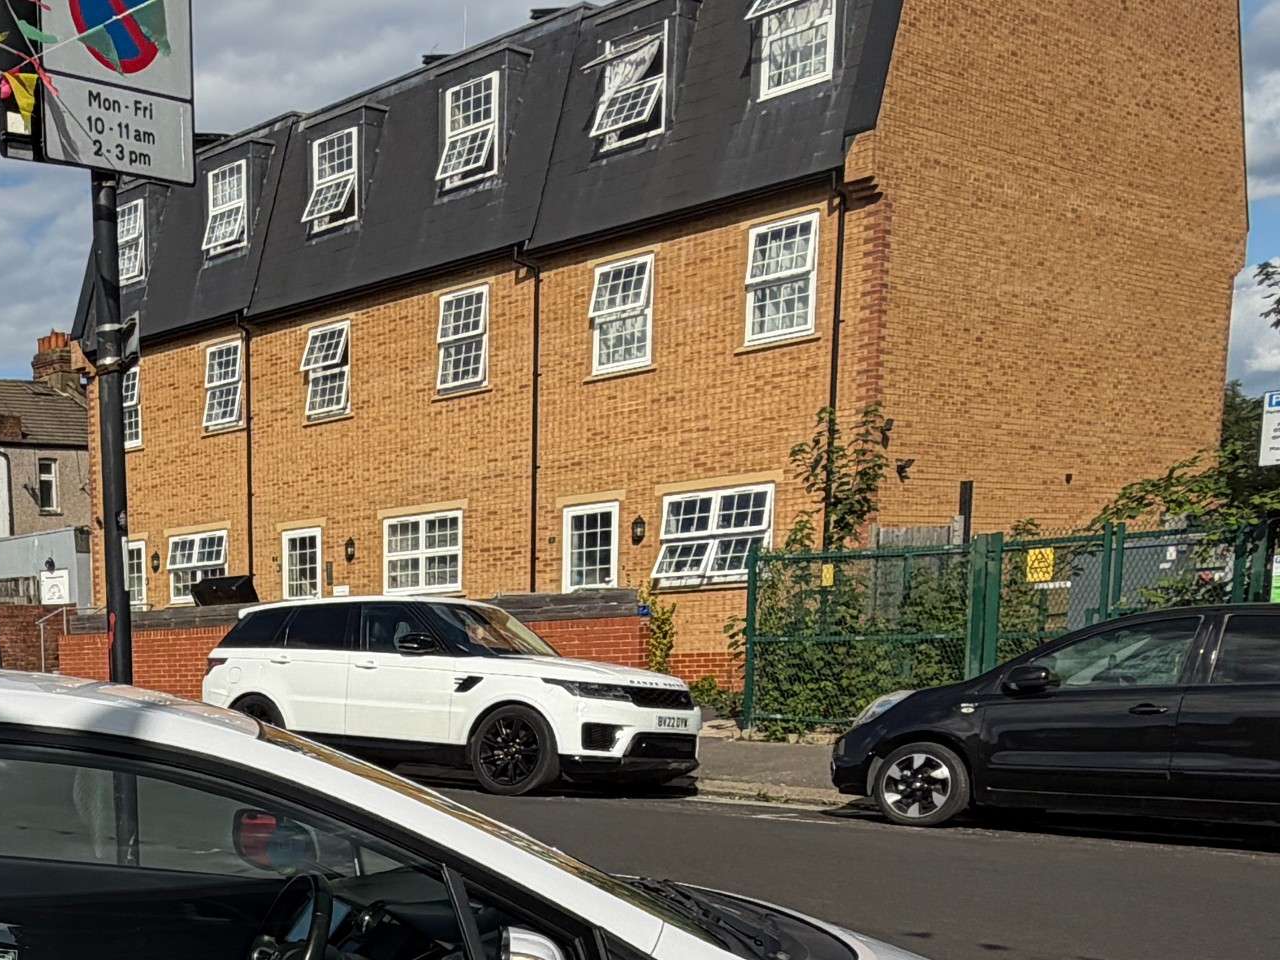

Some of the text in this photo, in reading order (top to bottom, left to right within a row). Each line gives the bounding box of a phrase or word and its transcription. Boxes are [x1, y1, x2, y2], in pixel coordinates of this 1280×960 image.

[88, 90, 121, 113] Mon
[134, 99, 153, 120] Fri
[129, 150, 151, 167] pm
